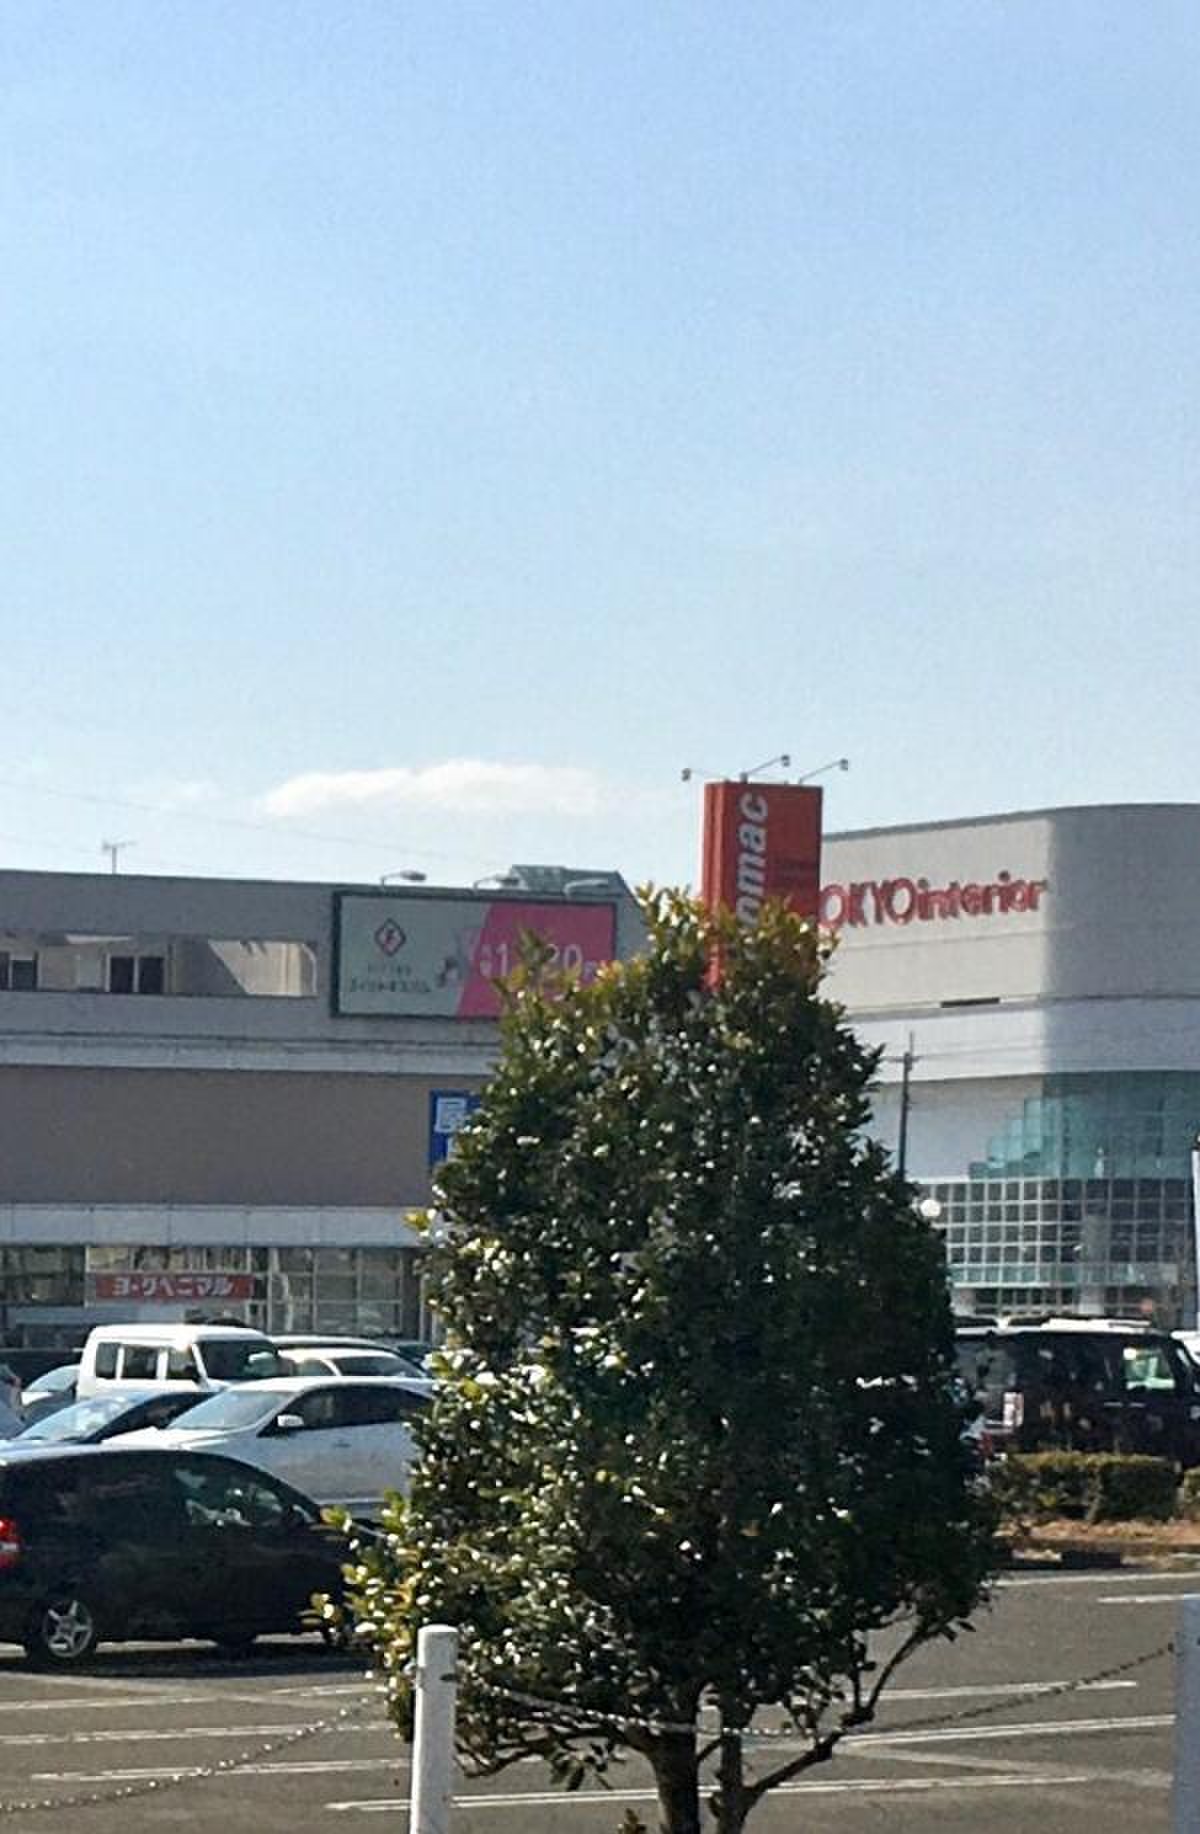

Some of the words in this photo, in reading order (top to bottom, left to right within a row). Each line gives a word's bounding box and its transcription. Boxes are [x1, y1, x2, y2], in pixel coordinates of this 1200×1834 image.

[737, 791, 768, 929] omac
[818, 877, 917, 929] OKYO
[917, 870, 1048, 921] interior
